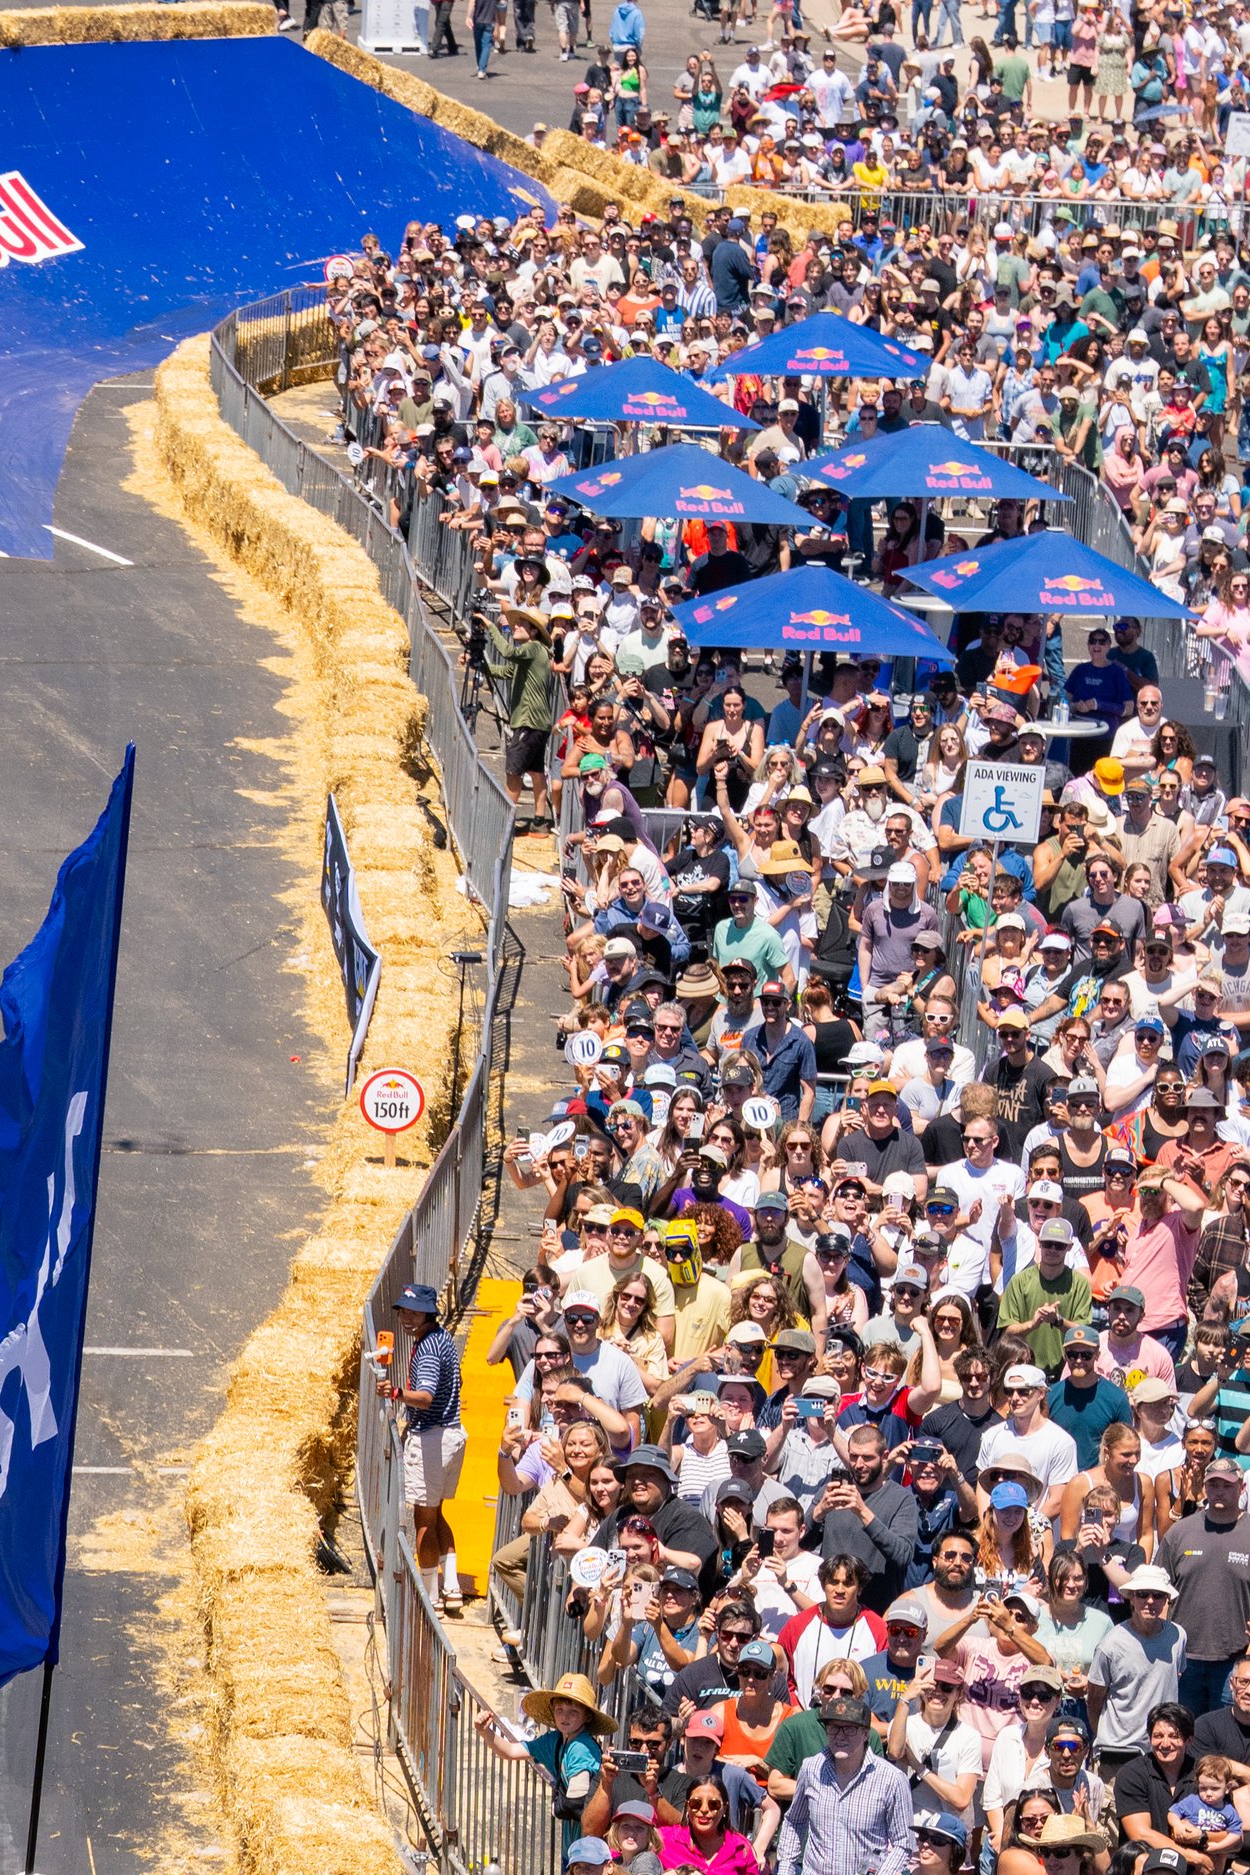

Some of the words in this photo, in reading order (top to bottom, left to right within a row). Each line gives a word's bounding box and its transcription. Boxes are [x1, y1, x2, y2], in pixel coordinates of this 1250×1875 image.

[787, 360, 818, 371] Red
[820, 360, 850, 371] Bull
[623, 405, 654, 416] Red
[655, 406, 687, 417] Bull
[926, 476, 958, 488] Red
[960, 477, 992, 489] Bull
[676, 501, 708, 512] Red
[710, 502, 744, 513] Bull
[1040, 592, 1076, 605] Red
[1078, 593, 1115, 606] Bull
[782, 626, 820, 640] Red
[822, 627, 861, 641] Bull
[974, 768, 996, 780] ADA
[997, 769, 1037, 784] VIEWING
[578, 1041, 595, 1058] 10
[1206, 1038, 1224, 1049] ATL
[376, 1090, 392, 1099] Red
[393, 1091, 409, 1099] Bull
[750, 1105, 769, 1123] 10
[552, 1125, 569, 1141] 10
